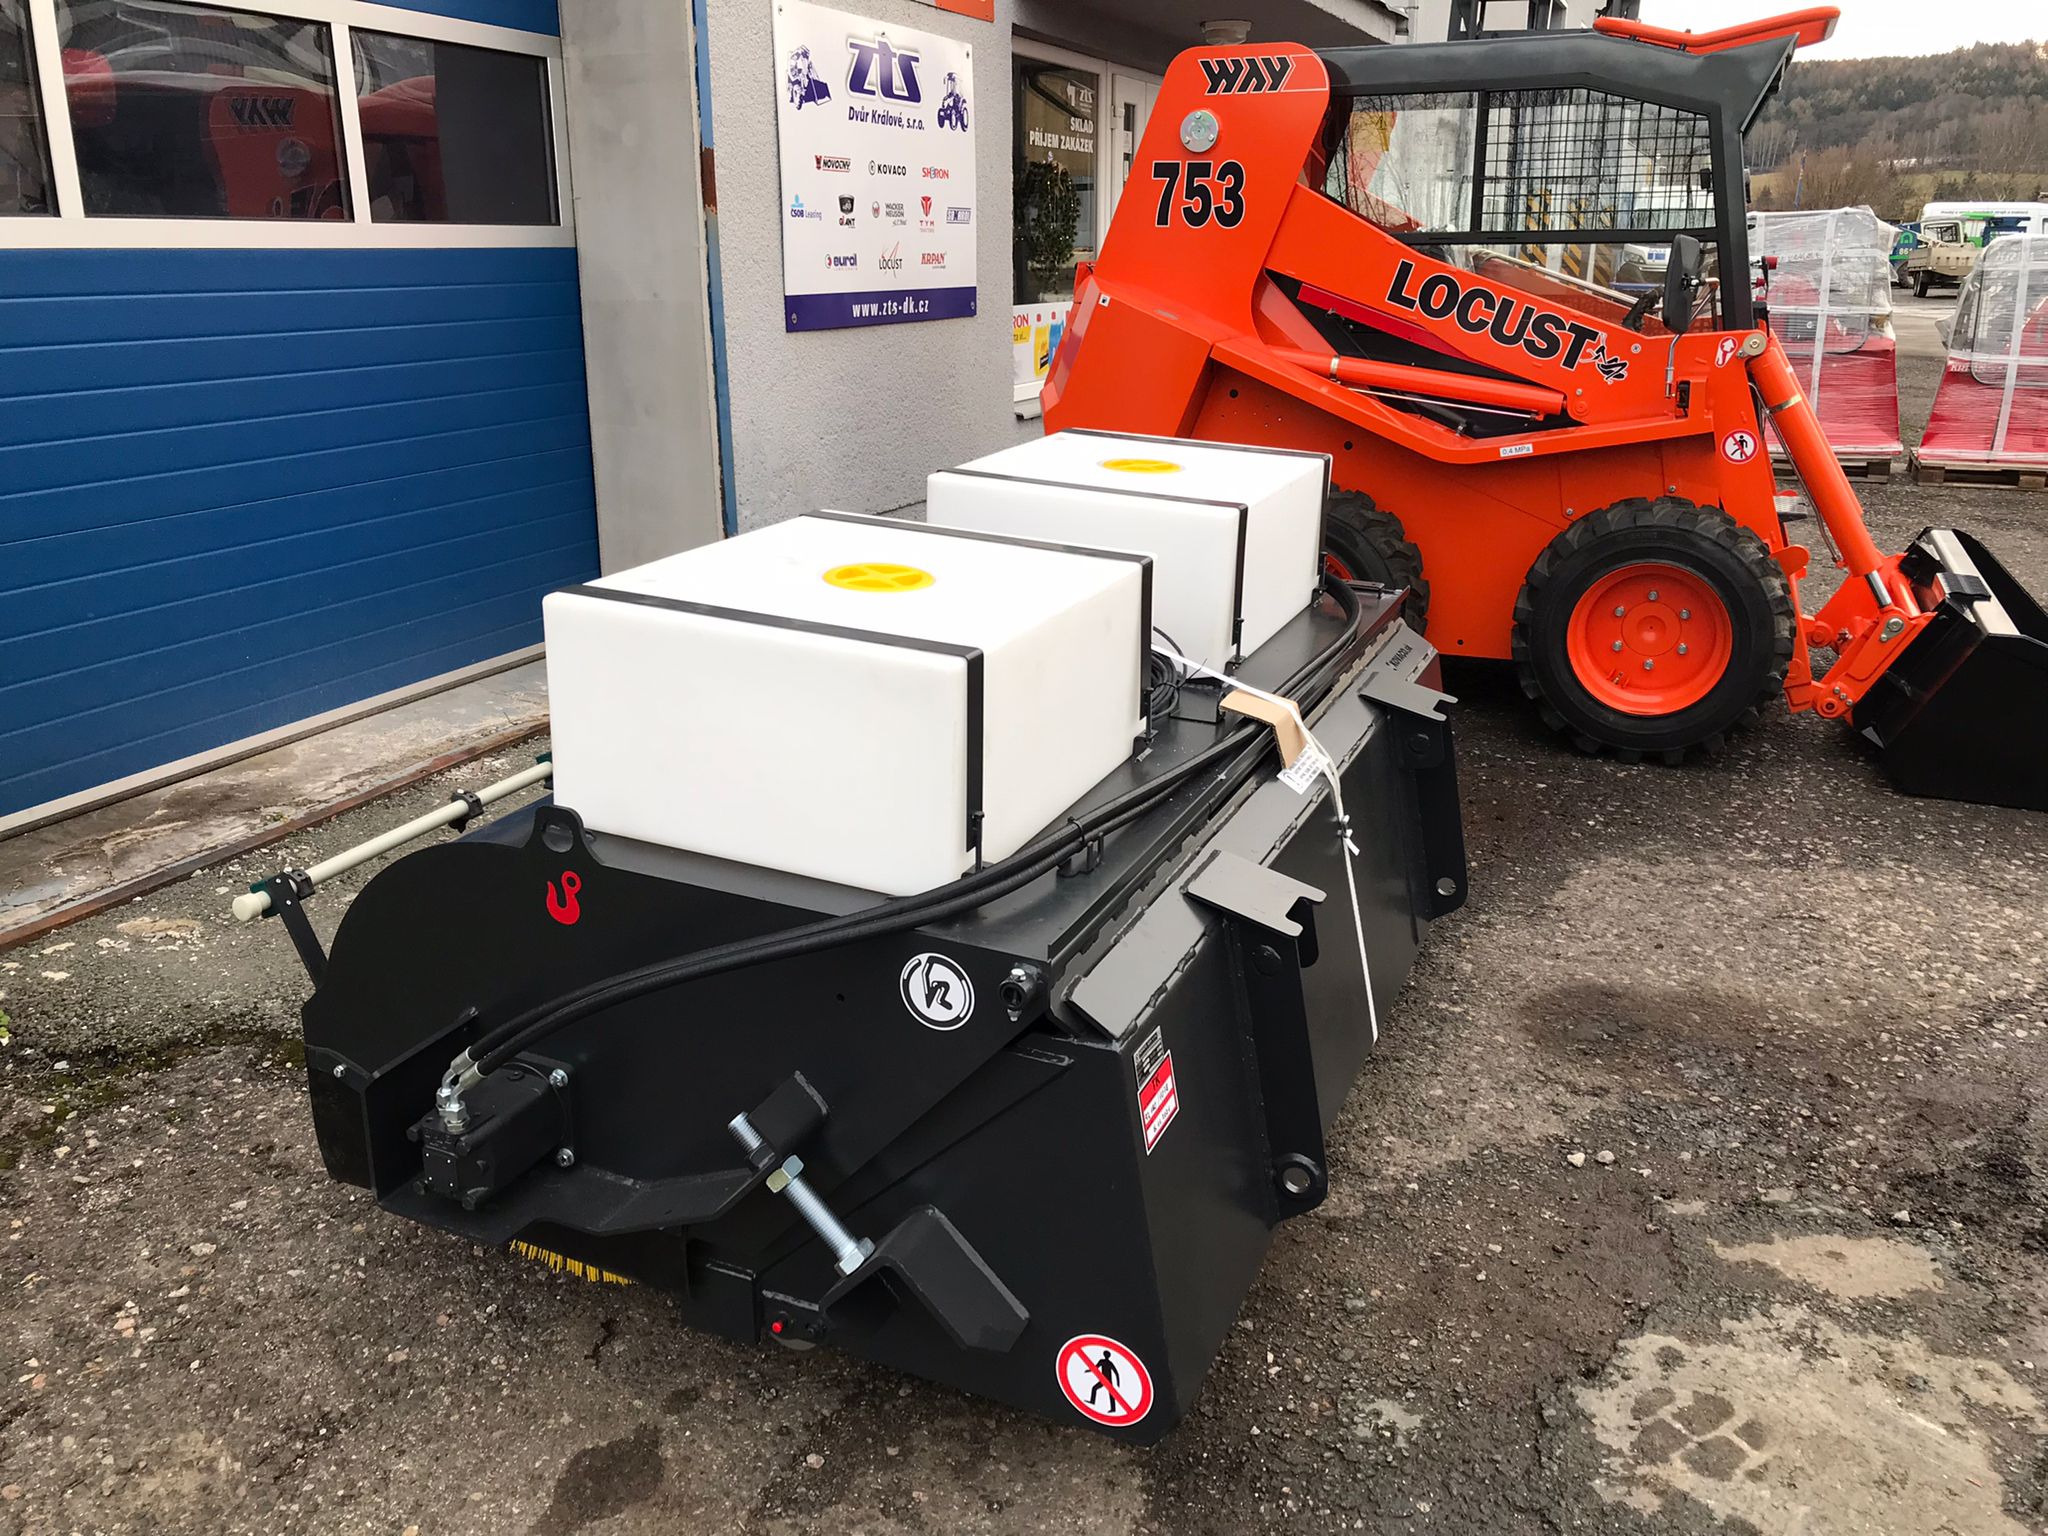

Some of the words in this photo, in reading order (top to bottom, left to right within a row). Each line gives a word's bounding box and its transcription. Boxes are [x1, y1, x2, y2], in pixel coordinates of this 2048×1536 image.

[849, 39, 922, 103] zts
[1199, 56, 1293, 94] WAY
[848, 105, 870, 123] Dvůr
[871, 109, 905, 129] Králové,
[906, 117, 925, 131] s.r.o.
[1070, 116, 1094, 134] SKLAD
[1029, 127, 1059, 149] PŘÍJEM
[1060, 132, 1094, 154] ZAKÁZEK
[877, 163, 907, 176] KOVACO
[922, 166, 949, 179] SHERON
[1152, 160, 1246, 229] 753
[833, 253, 857, 267] eurol
[878, 258, 903, 270] LOCUST
[920, 252, 946, 265] KRPAN
[852, 296, 930, 318] www.zts-dk.cz
[1385, 259, 1601, 371] LOCUST
